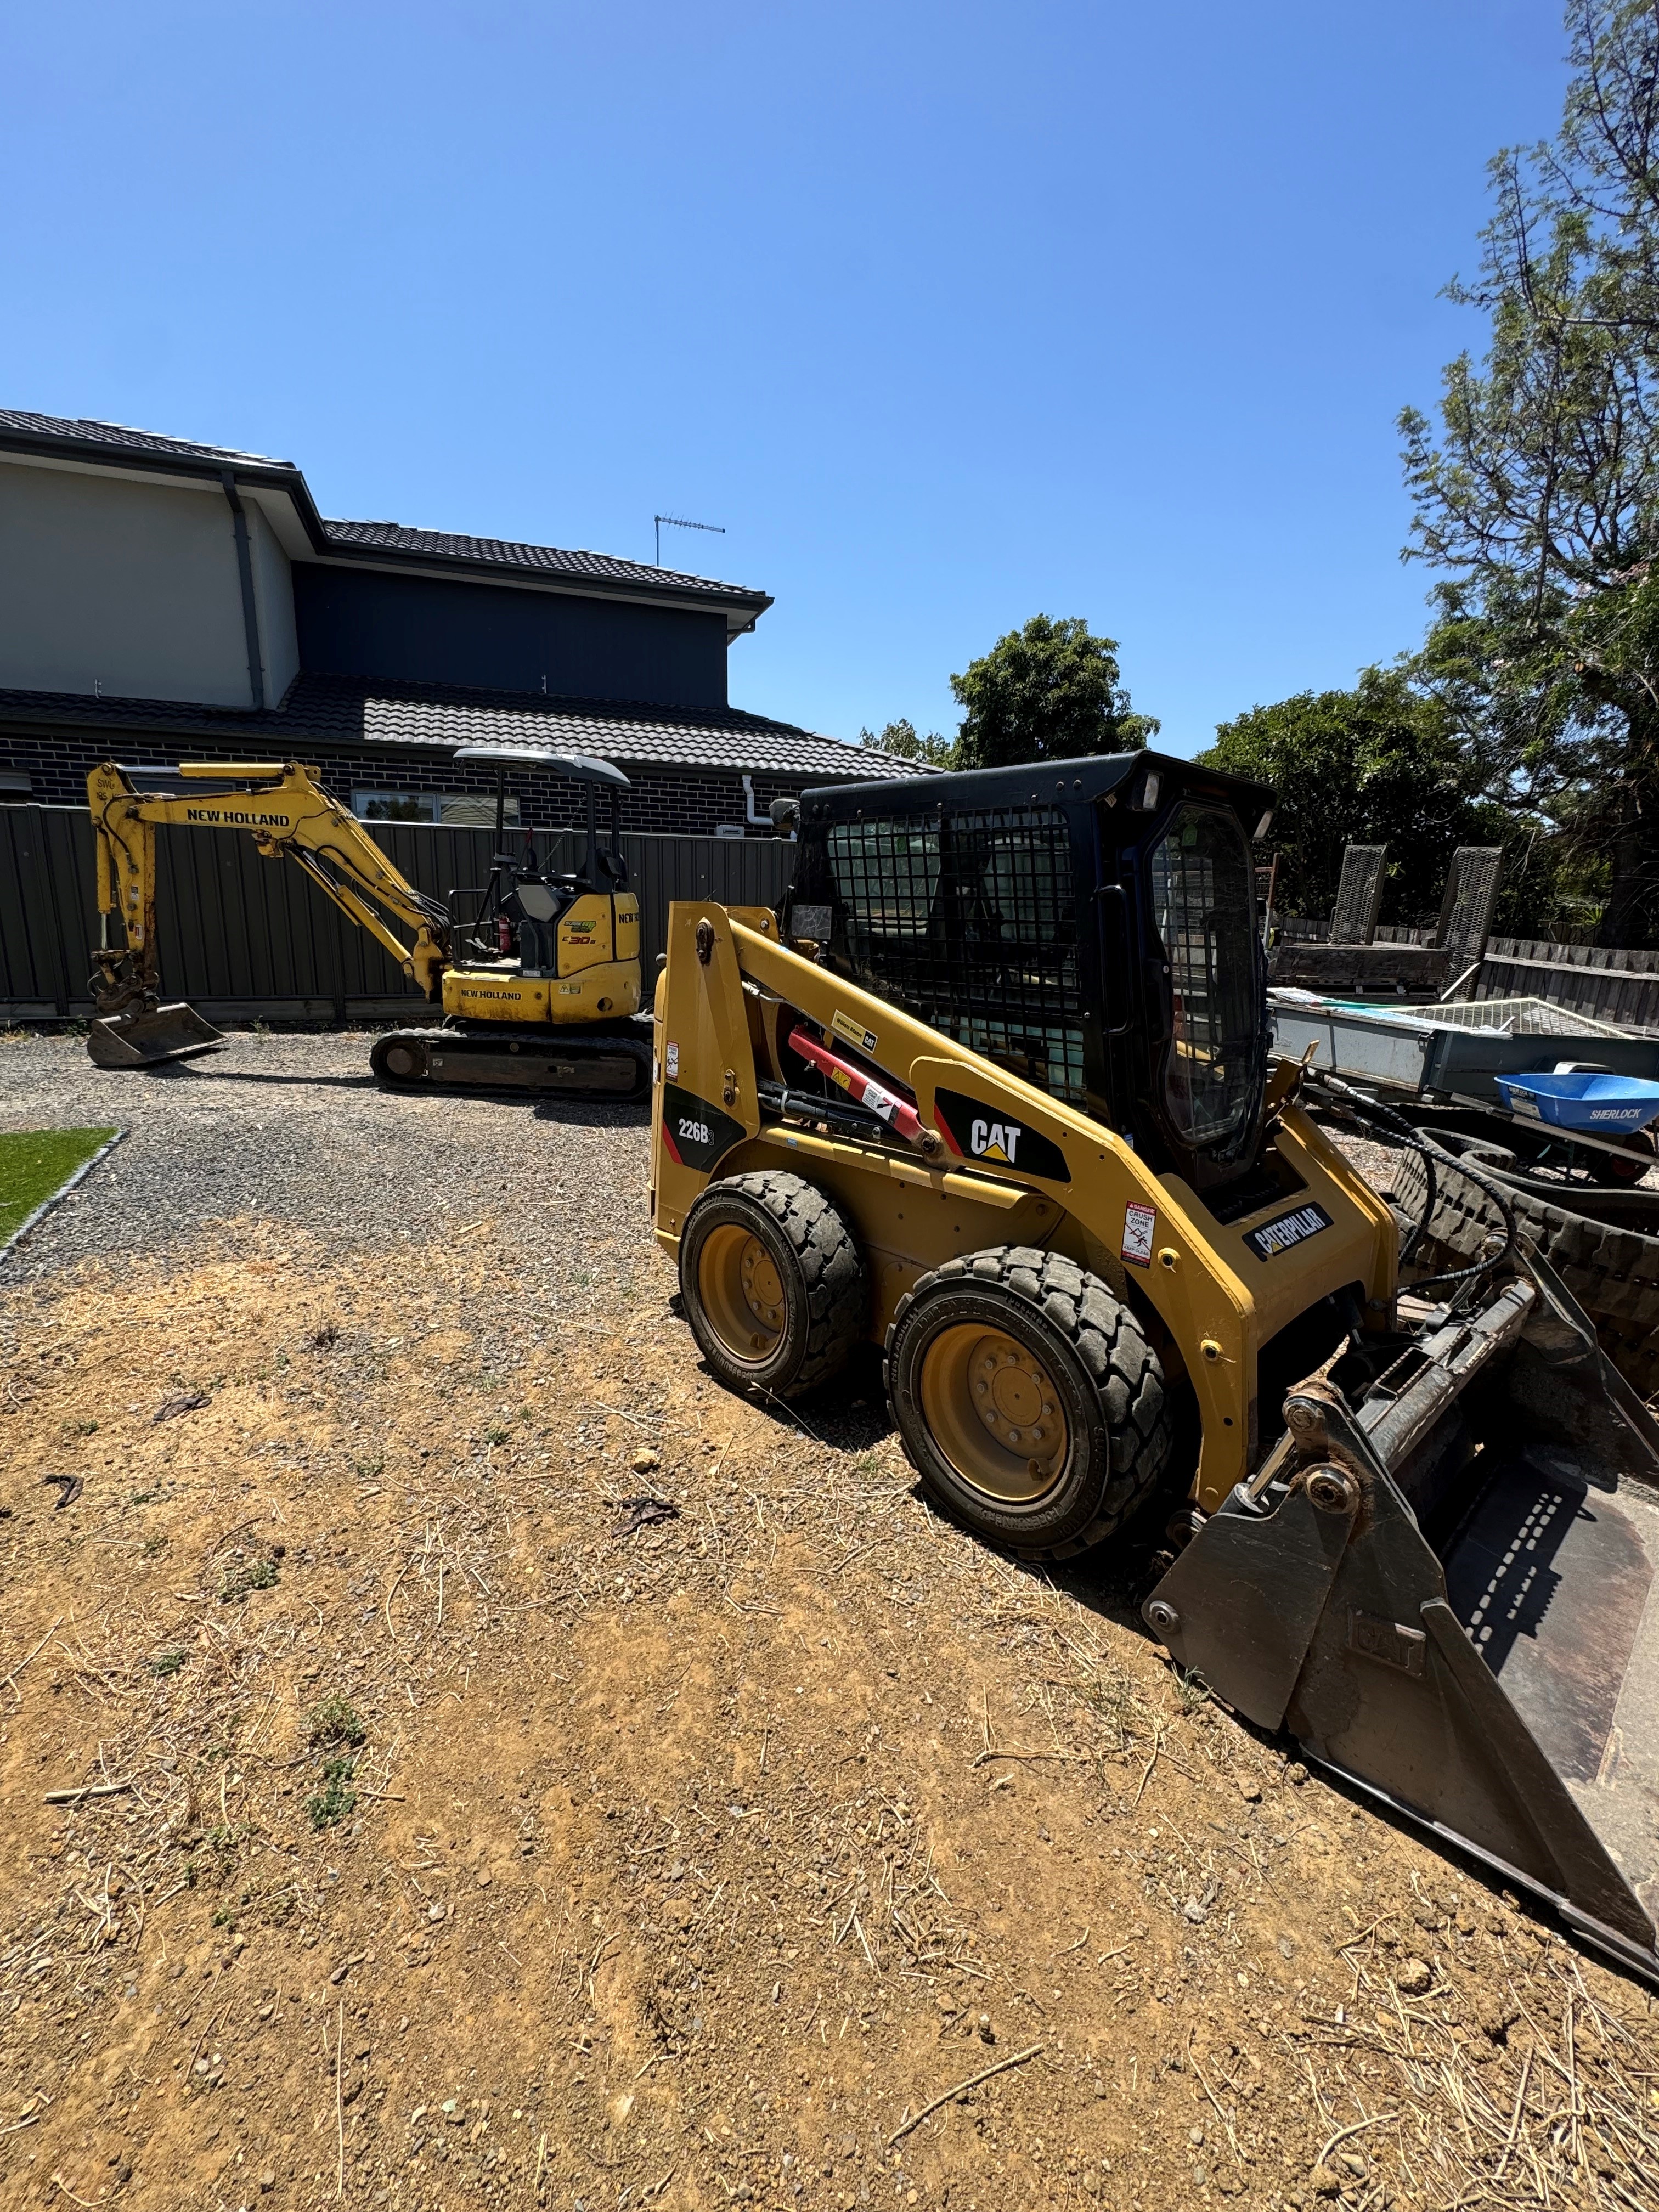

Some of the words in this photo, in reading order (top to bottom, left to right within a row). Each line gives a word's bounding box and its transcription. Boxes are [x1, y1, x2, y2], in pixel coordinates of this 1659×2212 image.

[97, 778, 115, 789] SWL
[187, 809, 220, 822] NEW
[223, 811, 290, 827] HOLLAND
[618, 913, 634, 924] NEW
[461, 989, 478, 998] NEW
[479, 990, 521, 1000] HOLLAND
[864, 1035, 875, 1048] CAT
[1589, 1108, 1642, 1120] SHERLOCK
[971, 1119, 1022, 1163] CAT
[1128, 1210, 1153, 1222] CRUSH
[1130, 1217, 1150, 1228] ZONE
[1254, 1207, 1326, 1254] CATERPILLAR
